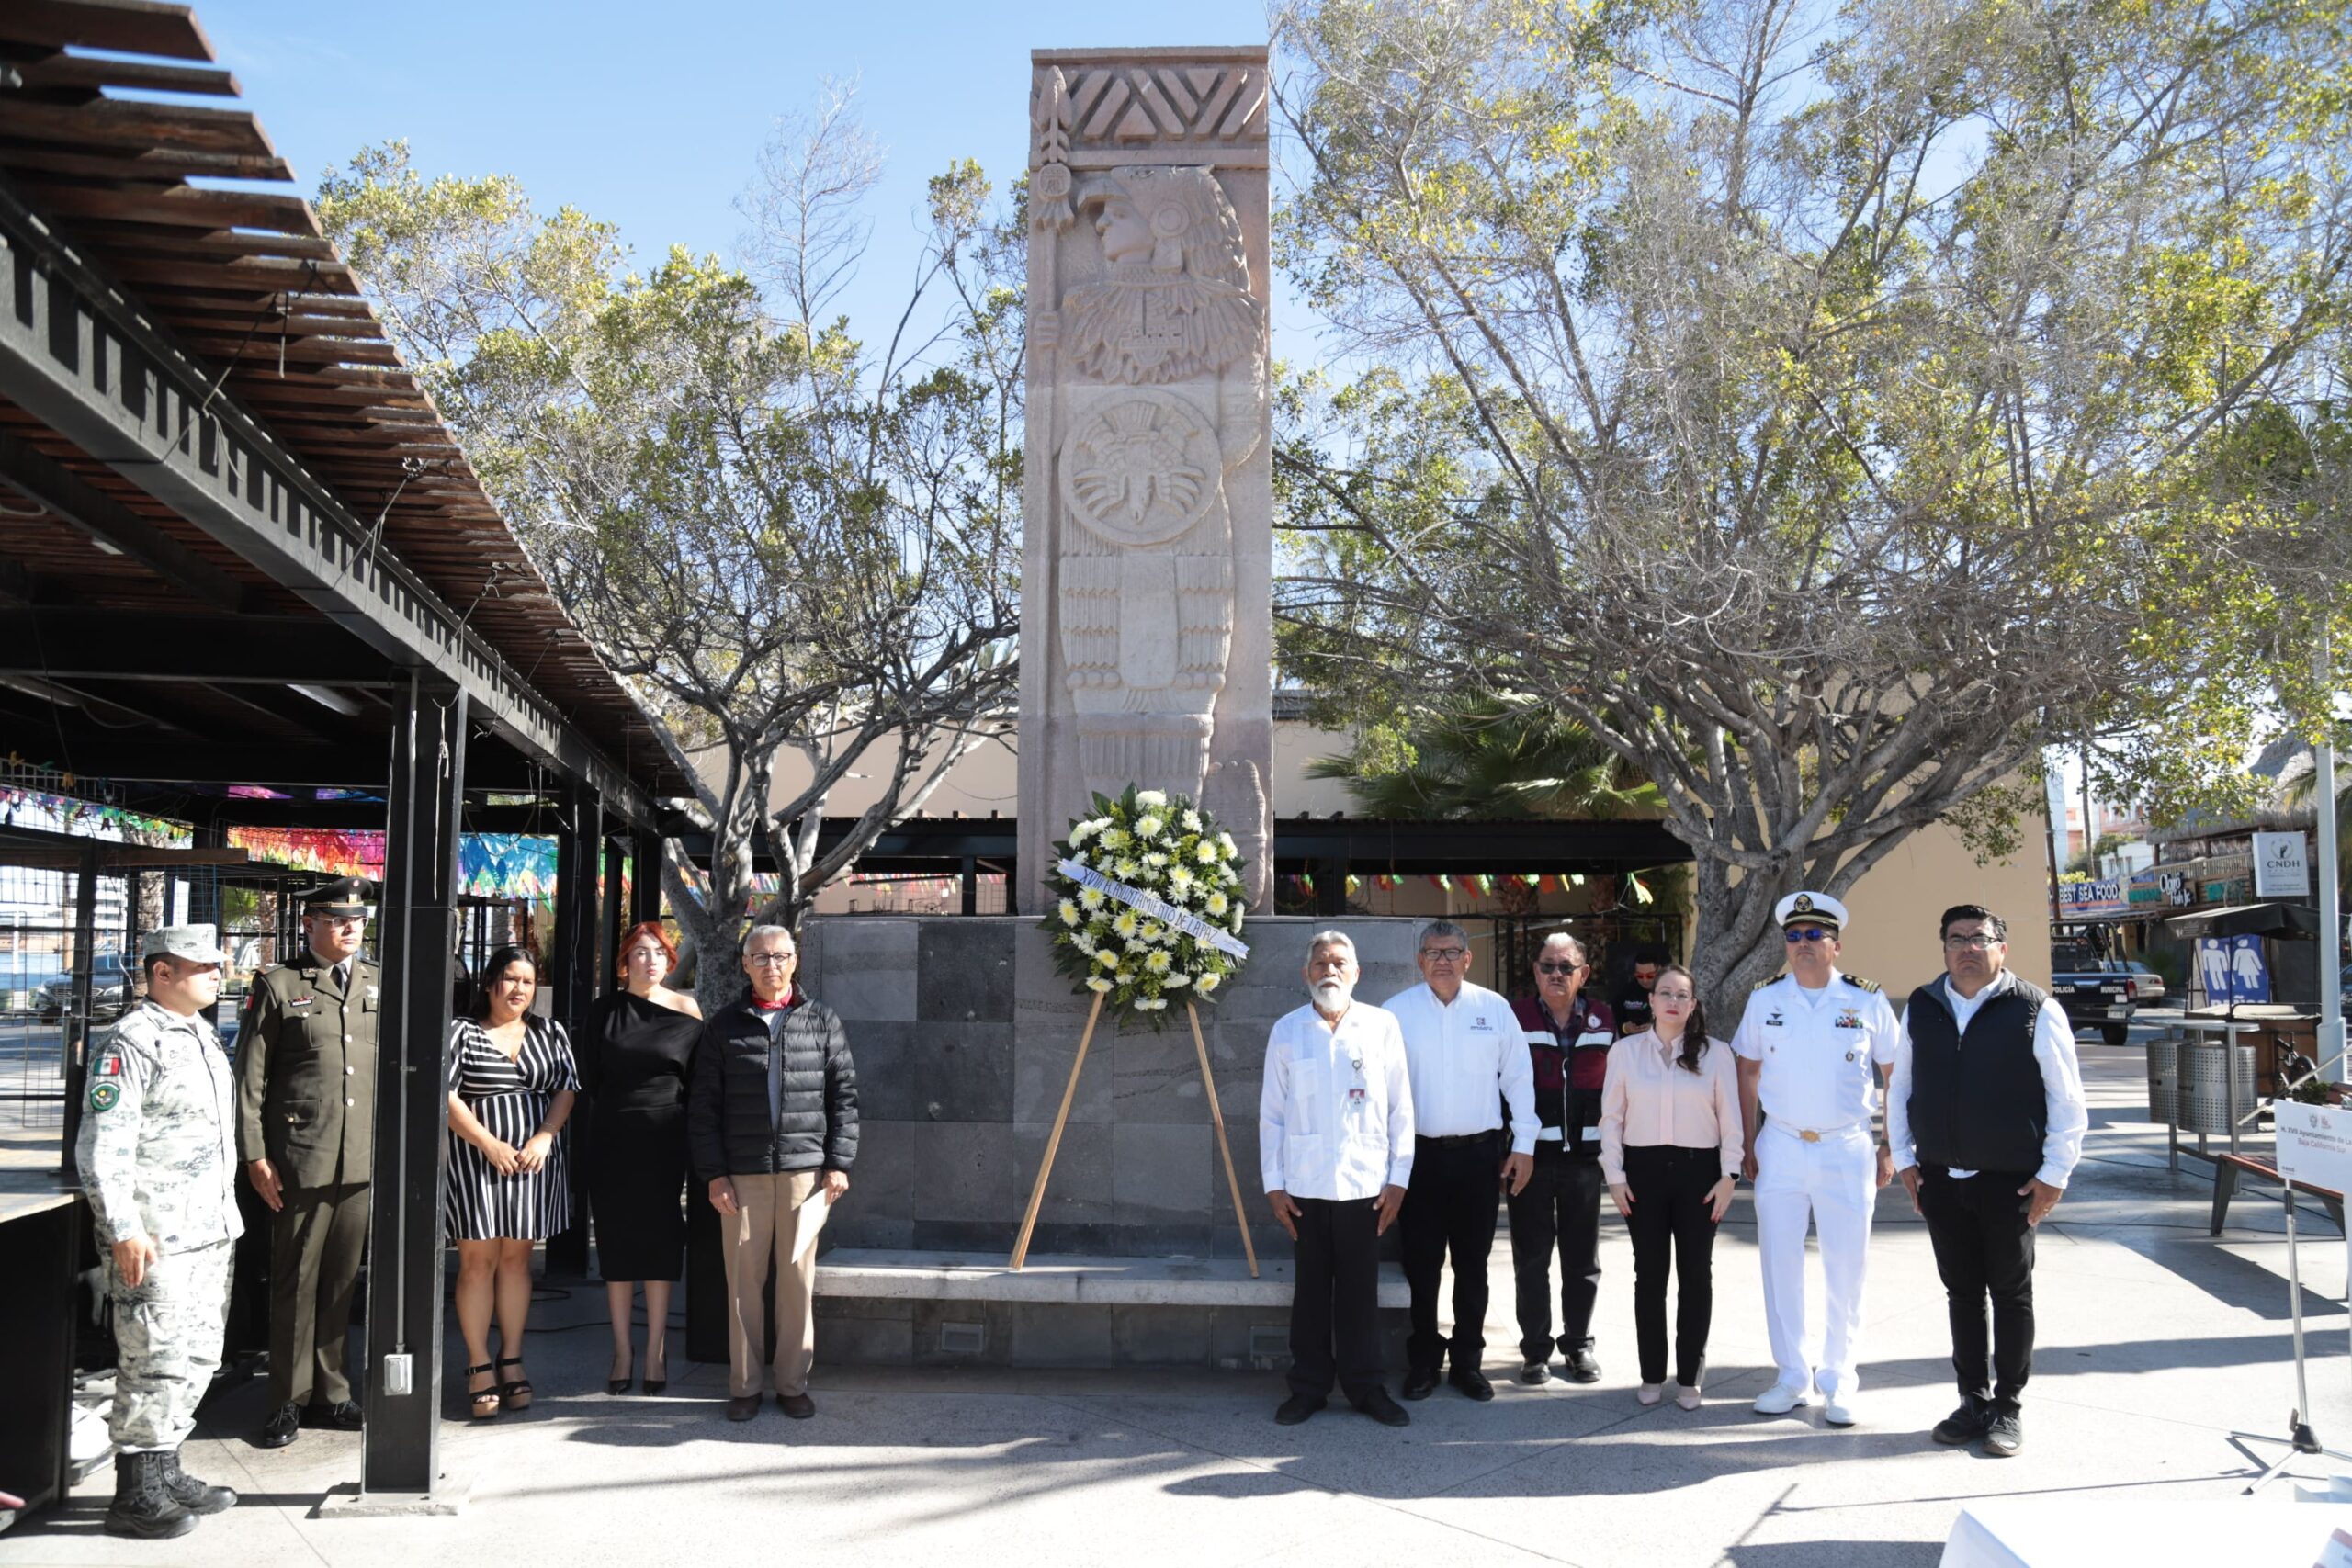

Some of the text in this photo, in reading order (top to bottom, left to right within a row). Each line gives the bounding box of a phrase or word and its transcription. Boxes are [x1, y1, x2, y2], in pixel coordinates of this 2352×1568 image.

[2267, 860, 2300, 868] CNDH
[2059, 886, 2076, 903] BEST
[2078, 886, 2094, 902] SEA
[2096, 884, 2118, 900] FOOD
[1113, 883, 1176, 922] AYUNTAMIENTO
[1175, 912, 1186, 930] DE
[1187, 917, 1200, 936] LA
[1199, 924, 1219, 944] PAZ
[2052, 985, 2125, 994] POLICÍA MUNICIPAL
[2300, 1129, 2336, 1142] Ayuntamiento
[2310, 1140, 2335, 1152] California
